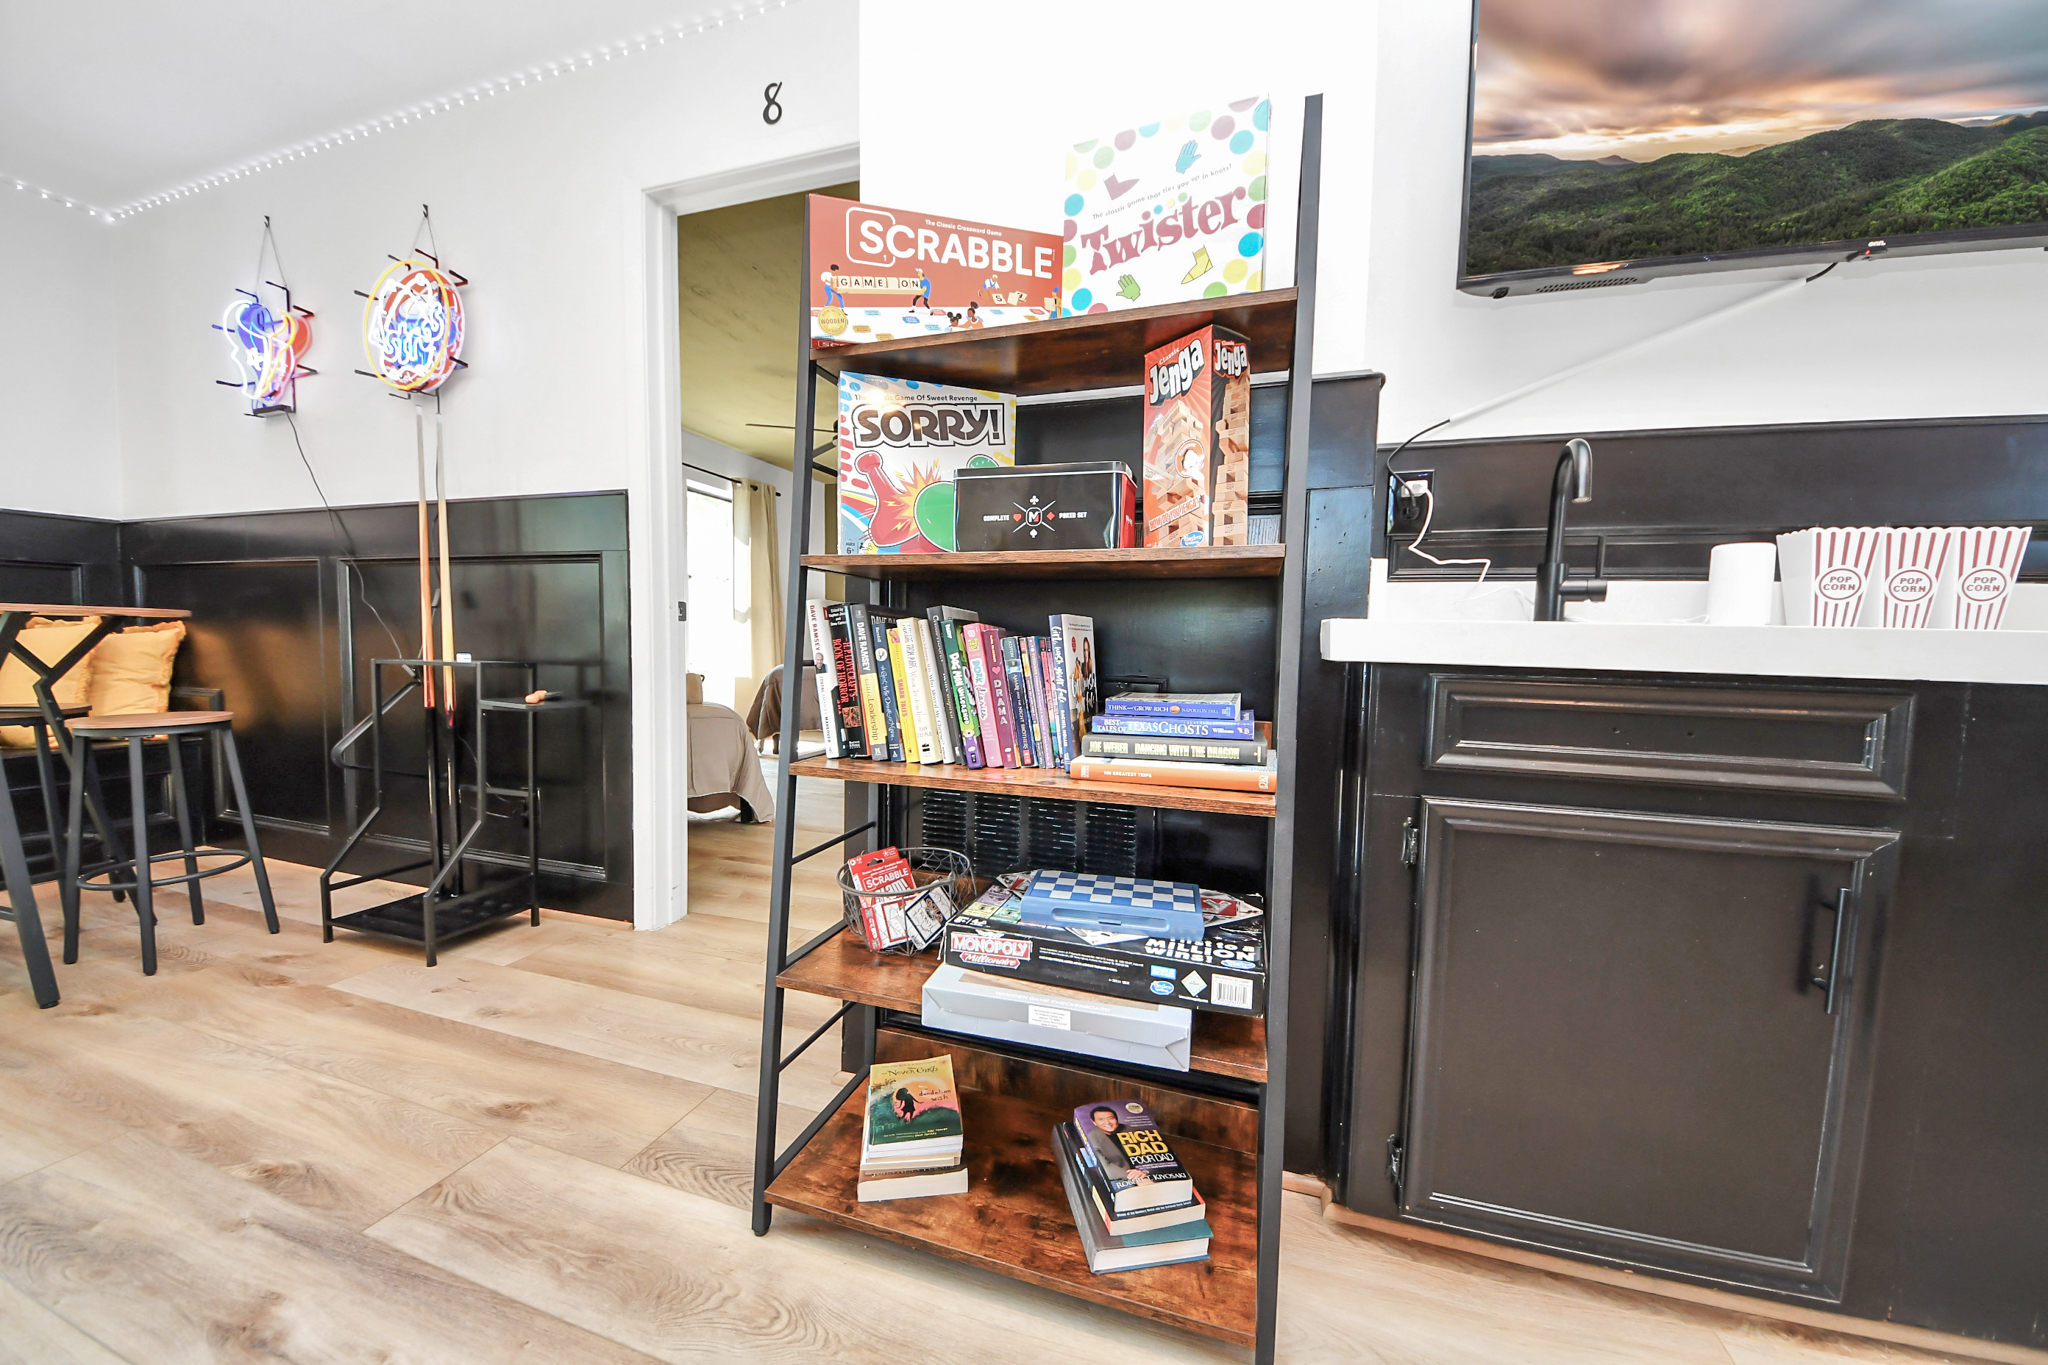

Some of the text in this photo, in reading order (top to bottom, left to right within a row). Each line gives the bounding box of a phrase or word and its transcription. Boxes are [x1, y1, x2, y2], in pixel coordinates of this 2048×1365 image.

[763, 81, 782, 125] 8
[1127, 196, 1145, 209] game
[1147, 192, 1161, 201] that
[1163, 185, 1175, 194] ties
[1177, 180, 1189, 190] you
[936, 221, 956, 229] Classic
[956, 225, 986, 234] Crossword
[1081, 186, 1246, 275] Twister
[859, 219, 1053, 279] SCRABBLE
[840, 277, 919, 289] GAME ON
[1159, 347, 1180, 365] Classic
[1215, 342, 1248, 377] Jenga
[1150, 339, 1205, 404] Jenga
[856, 407, 1002, 443] SORRY!
[983, 514, 1010, 522] COMPLETE
[1893, 585, 1926, 593] CORN
[1966, 584, 2001, 592] CORN
[811, 623, 820, 651] RAMSEY
[1050, 625, 1062, 644] Girl,
[833, 638, 843, 660] BOOK
[856, 622, 871, 671] DAVE RAMSEY
[835, 661, 845, 671] OF
[843, 642, 858, 698] H.P. LOVECRAFT'S
[971, 658, 984, 683] DORK
[837, 672, 849, 703] HORROR
[896, 678, 905, 698] SHARK
[948, 651, 970, 725] DOG MAN UNLEASHED
[975, 686, 991, 719] diaries
[993, 679, 1008, 724] DRAMA
[1017, 706, 1025, 723] NIGHT
[1019, 723, 1029, 749] BROTHERS
[1127, 721, 1209, 735] TEXAS GHOSTS
[1089, 741, 1102, 752] JOE
[1103, 742, 1128, 754] WEBER
[1134, 742, 1167, 756] DANCING
[1168, 744, 1190, 756] WITH
[1191, 745, 1206, 758] THE
[1207, 746, 1240, 759] DRAGON
[866, 868, 909, 889] SCRABBLE
[954, 935, 1028, 957] MONOPOLY
[1144, 946, 1213, 964] Wins!
[1145, 938, 1256, 961] MILLION
[1216, 942, 1238, 951] to
[965, 953, 1017, 966] Millionaire
[995, 991, 1028, 1000] WOODEN
[1050, 999, 1111, 1012] CHECKERBOARD
[919, 1088, 951, 1096] dandelion
[1117, 1129, 1162, 1145] RICH
[1123, 1141, 1169, 1157] DAD
[1130, 1153, 1174, 1165] POOR DAD
[1116, 1176, 1145, 1189] ROBERT
[1153, 1172, 1187, 1180] KIYOSAKI
